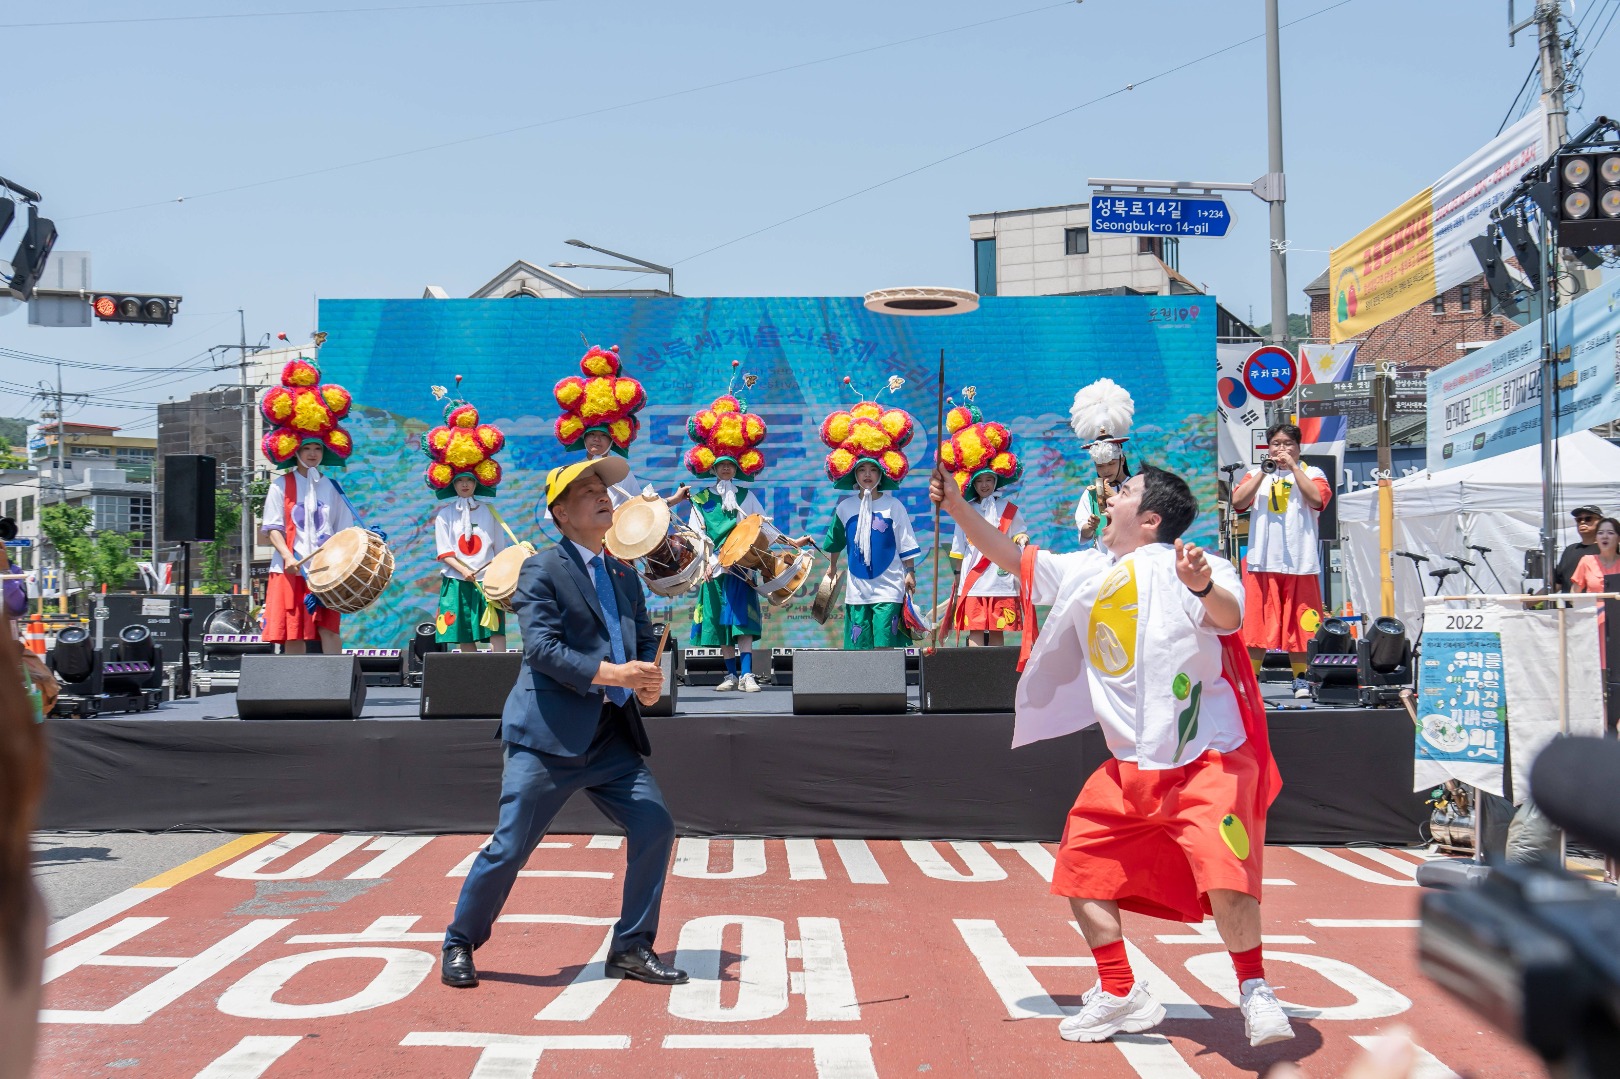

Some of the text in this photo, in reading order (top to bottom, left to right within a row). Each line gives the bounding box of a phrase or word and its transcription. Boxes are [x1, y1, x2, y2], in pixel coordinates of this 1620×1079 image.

[1096, 198, 1182, 219] 성북로14길
[1095, 219, 1209, 234] Seongbuk-ro 14-gil
[1250, 366, 1291, 379] 주차금지
[1472, 384, 1503, 419] 프로젝트
[1446, 615, 1484, 630] 2022
[1453, 651, 1502, 669] 우리를
[1464, 670, 1500, 688] 구할
[1463, 690, 1499, 708] 가장
[1467, 729, 1498, 758] 맛
